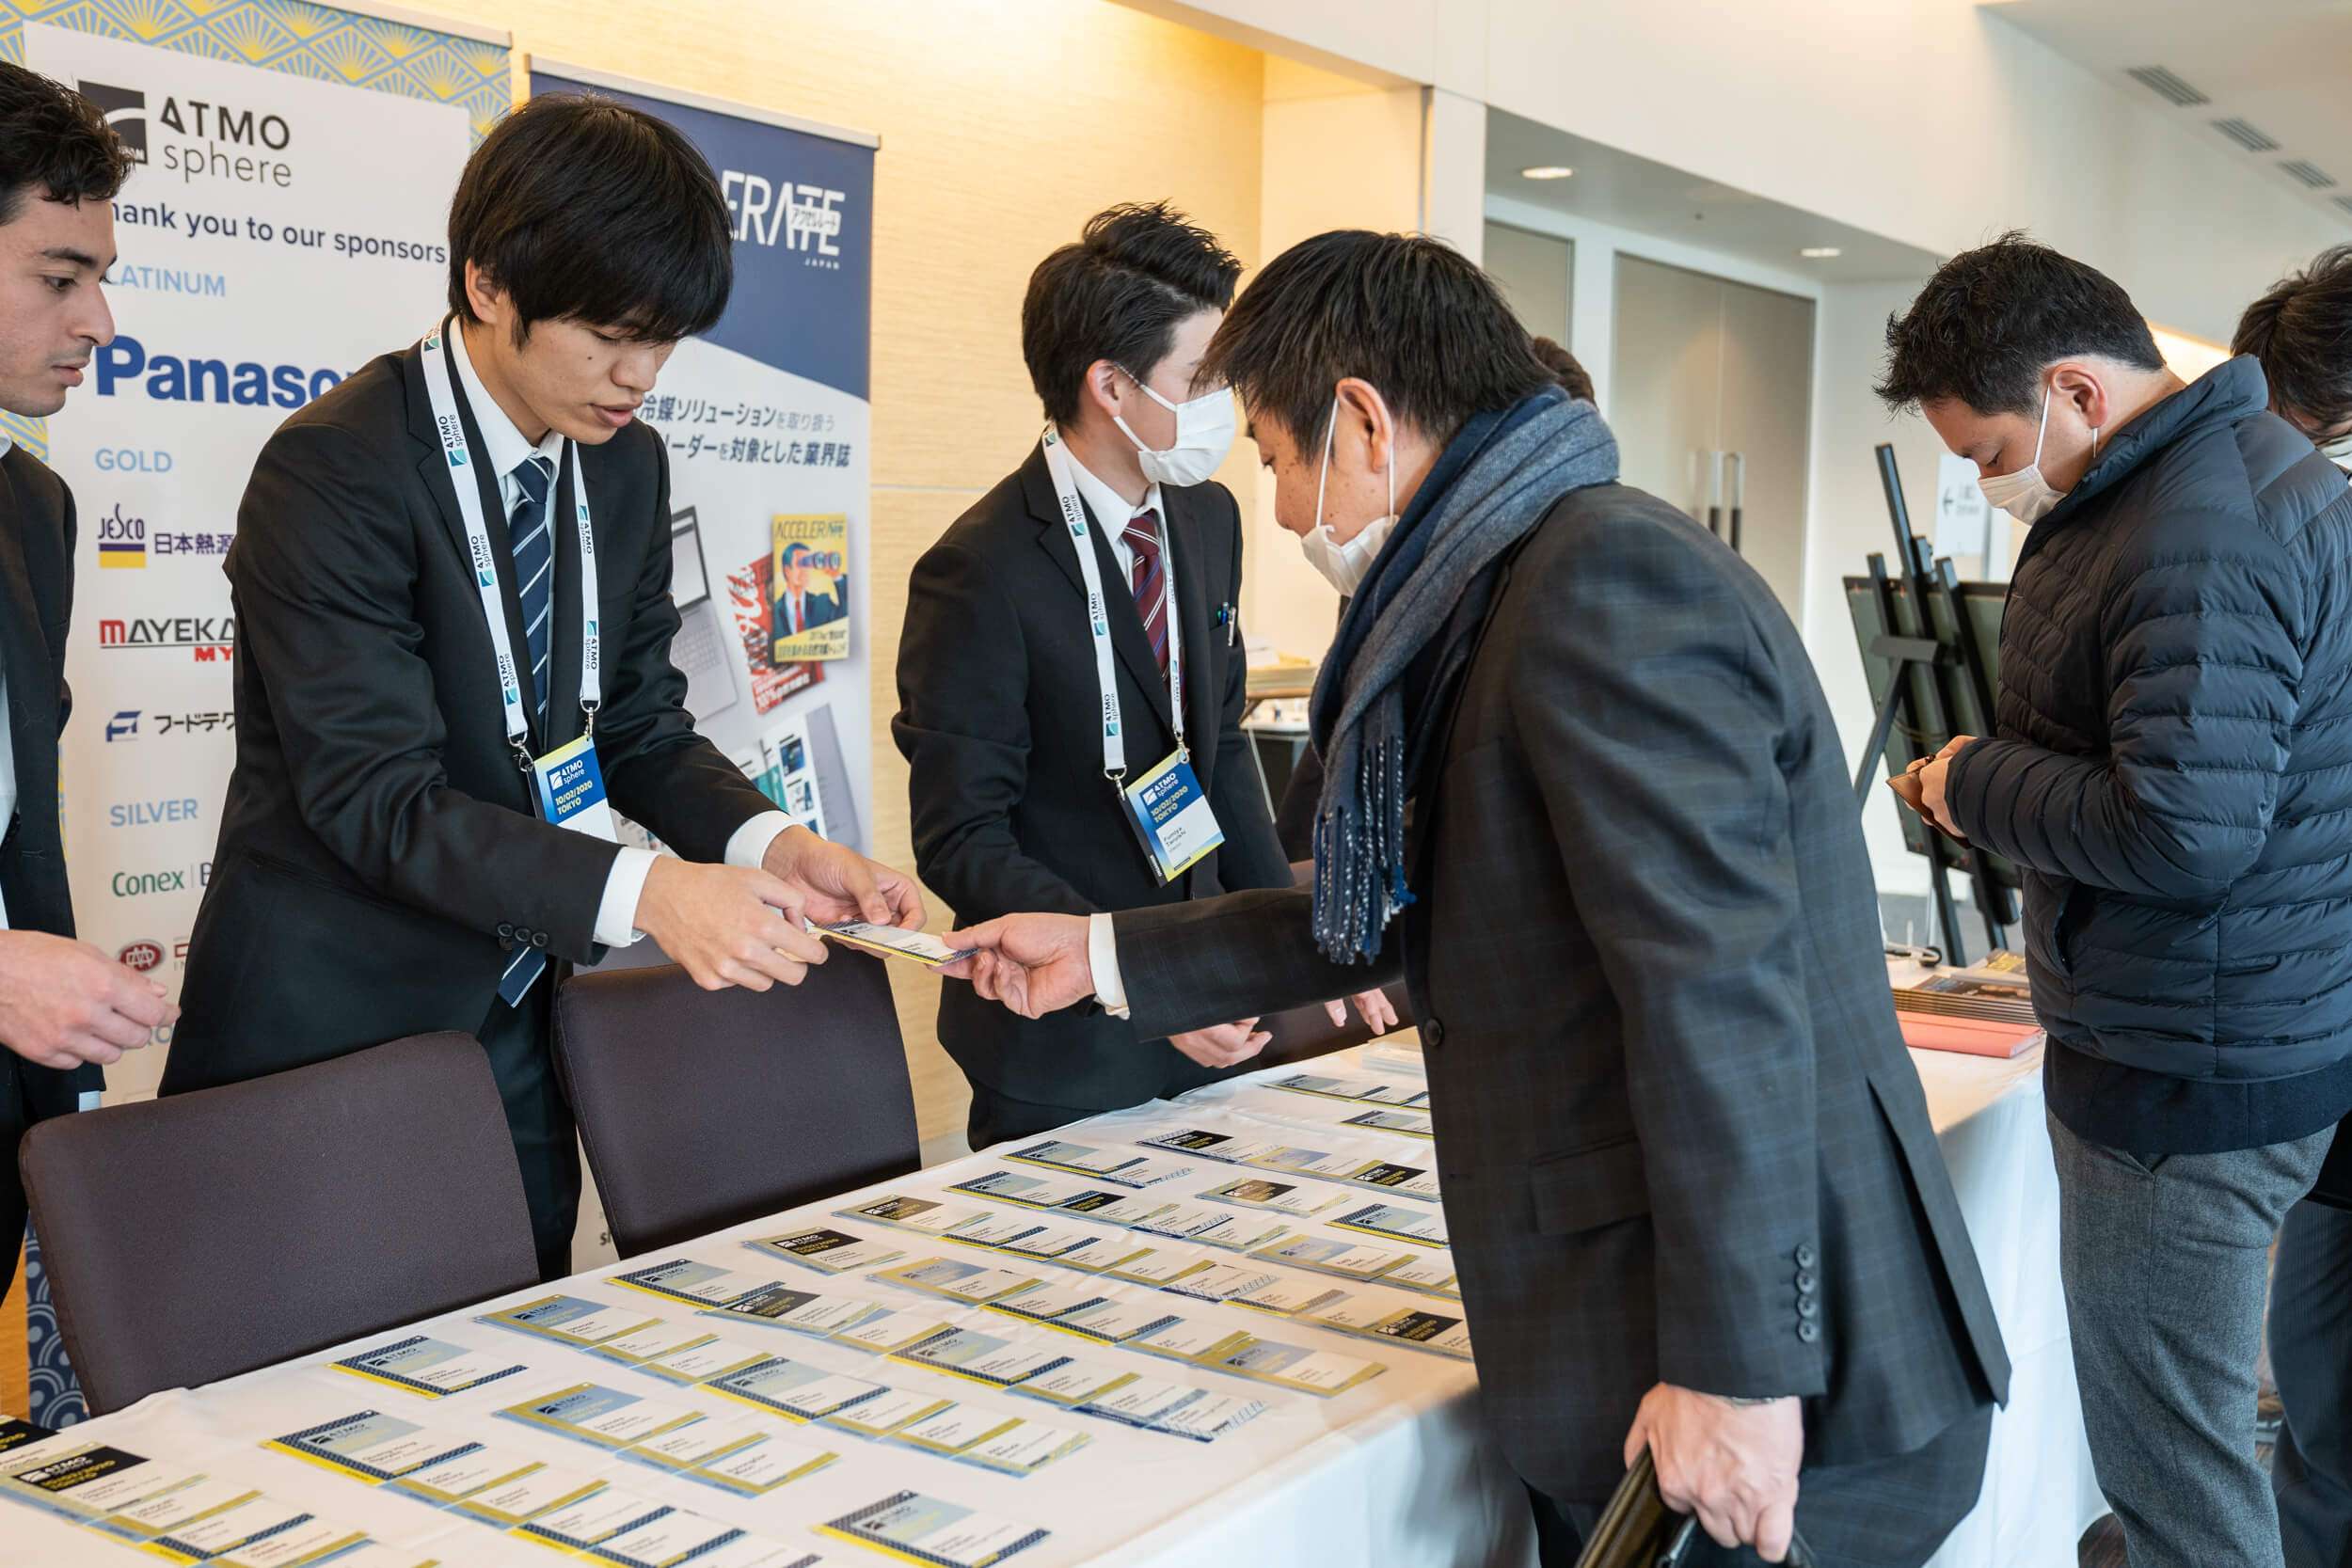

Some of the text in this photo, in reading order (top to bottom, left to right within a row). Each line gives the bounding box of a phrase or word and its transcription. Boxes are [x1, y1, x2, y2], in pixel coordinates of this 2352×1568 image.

[160, 96, 291, 150] ATMO
[164, 141, 292, 187] sphere
[112, 202, 446, 263] ank you to our sponsors
[104, 265, 226, 297] LATINUM
[95, 335, 357, 409] Panaso
[438, 416, 453, 449] ATMO
[448, 414, 464, 447] sphere
[96, 449, 172, 471] GOLD
[97, 502, 145, 540] JESCO
[1061, 497, 1075, 523] ATMO
[470, 535, 484, 569] ATMO
[1089, 593, 1100, 621] ATMO
[499, 655, 511, 688] ATMO
[1104, 693, 1113, 722] ATMO
[561, 759, 583, 777] ATMO
[563, 768, 585, 785] sphere
[1153, 772, 1176, 792] ATMO
[555, 780, 593, 806] 10/02/2020
[1151, 785, 1188, 816] 10/02/2020
[1157, 779, 1179, 798] sphere
[109, 799, 199, 828] SILVER
[557, 798, 582, 816] TOKYO
[1154, 802, 1178, 823] TOKYO
[112, 870, 185, 897] Conex
